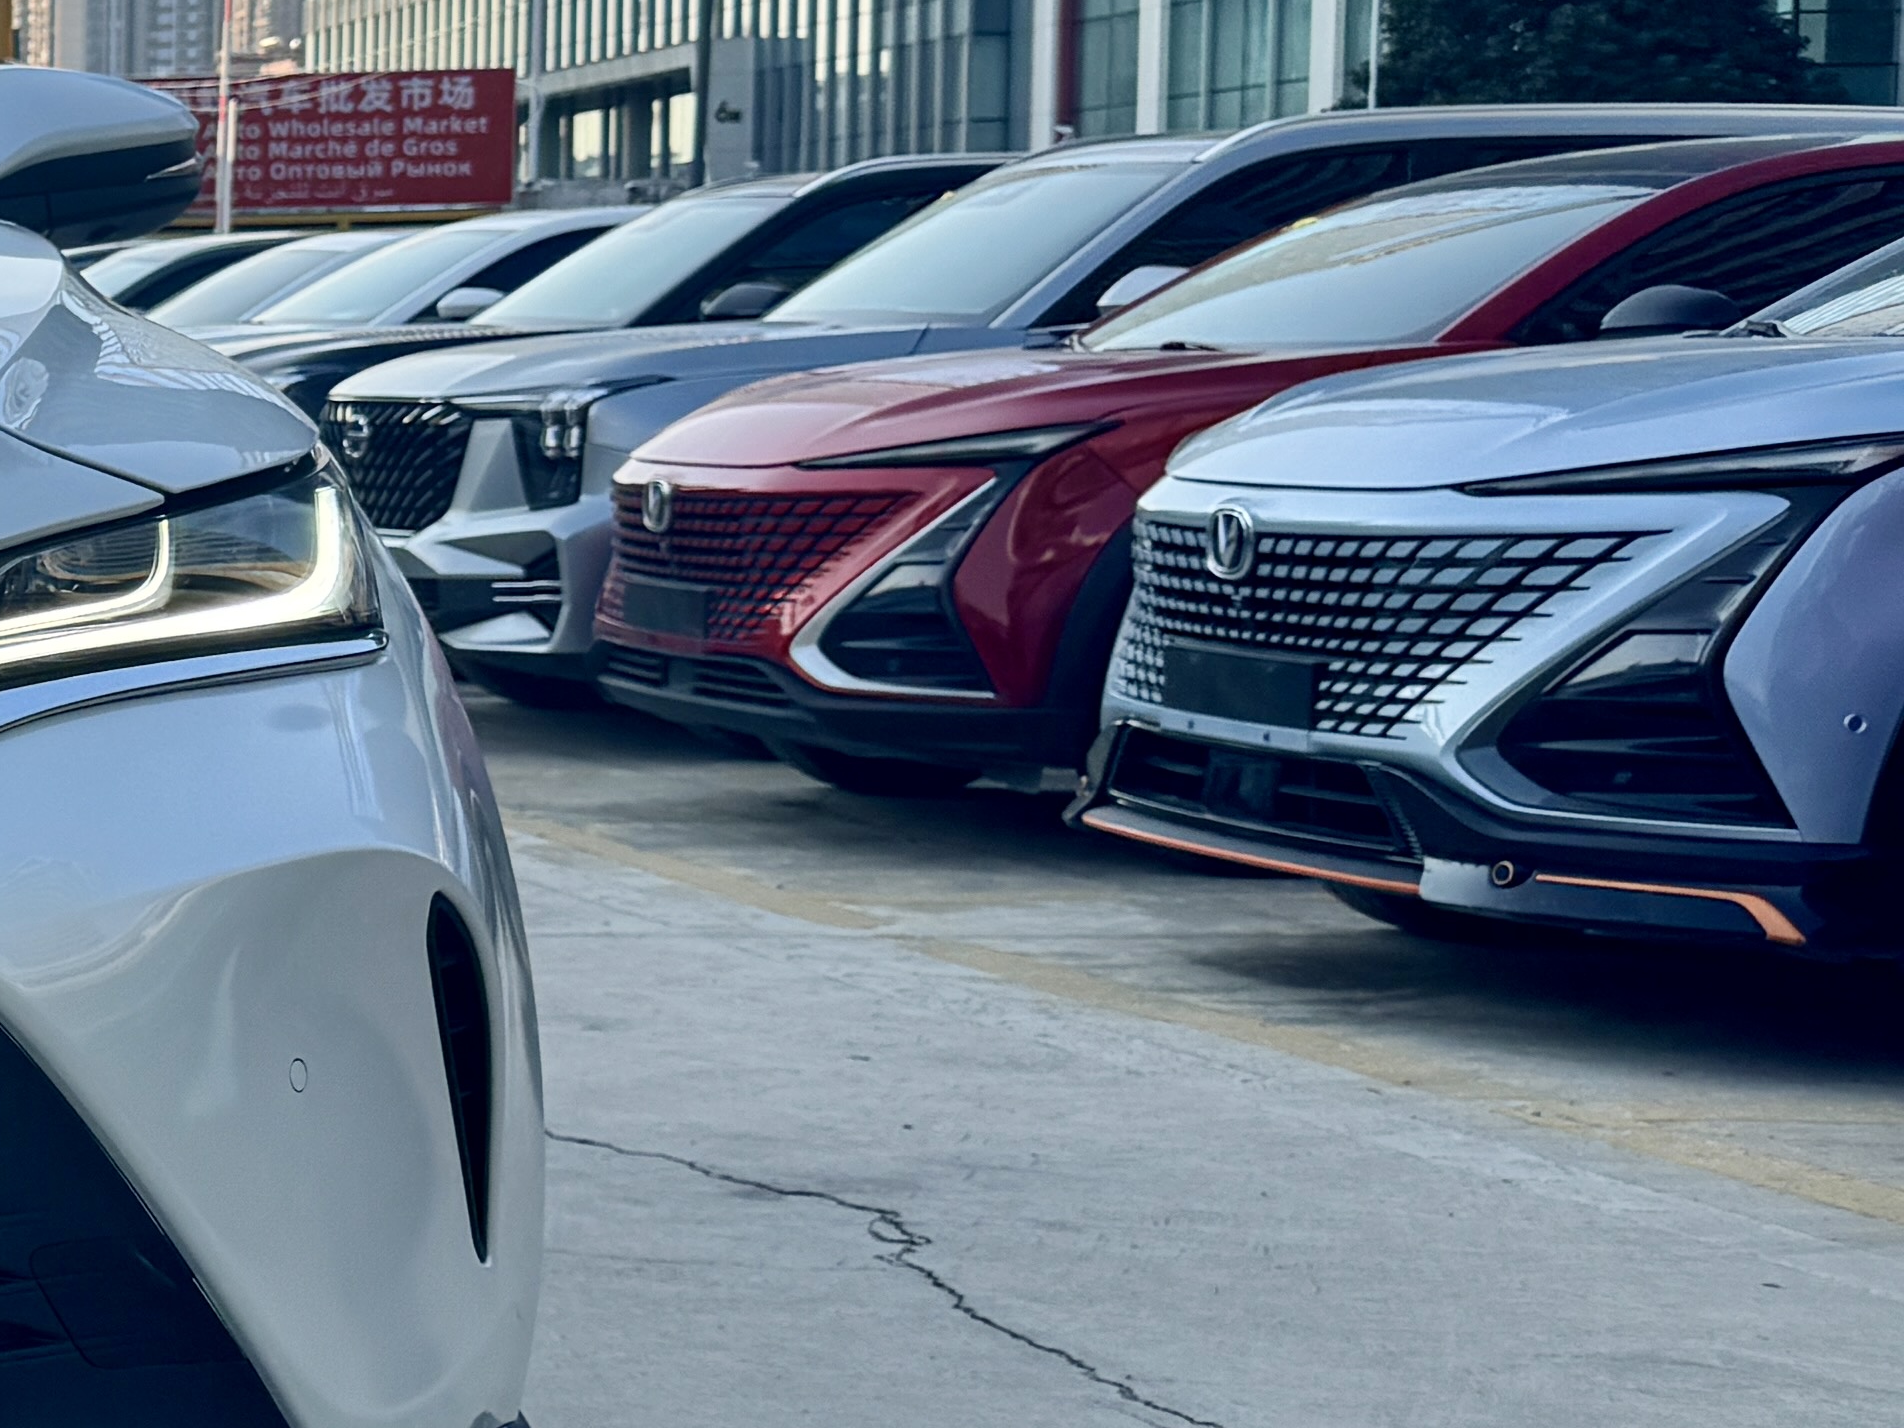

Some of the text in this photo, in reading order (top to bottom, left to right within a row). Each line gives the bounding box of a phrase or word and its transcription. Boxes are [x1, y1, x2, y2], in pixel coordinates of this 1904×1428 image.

[202, 116, 489, 140] Ato Wholesale Market
[202, 138, 459, 161] Ato Marché de Gros
[202, 158, 472, 181] Ато Оптовый Рынок
